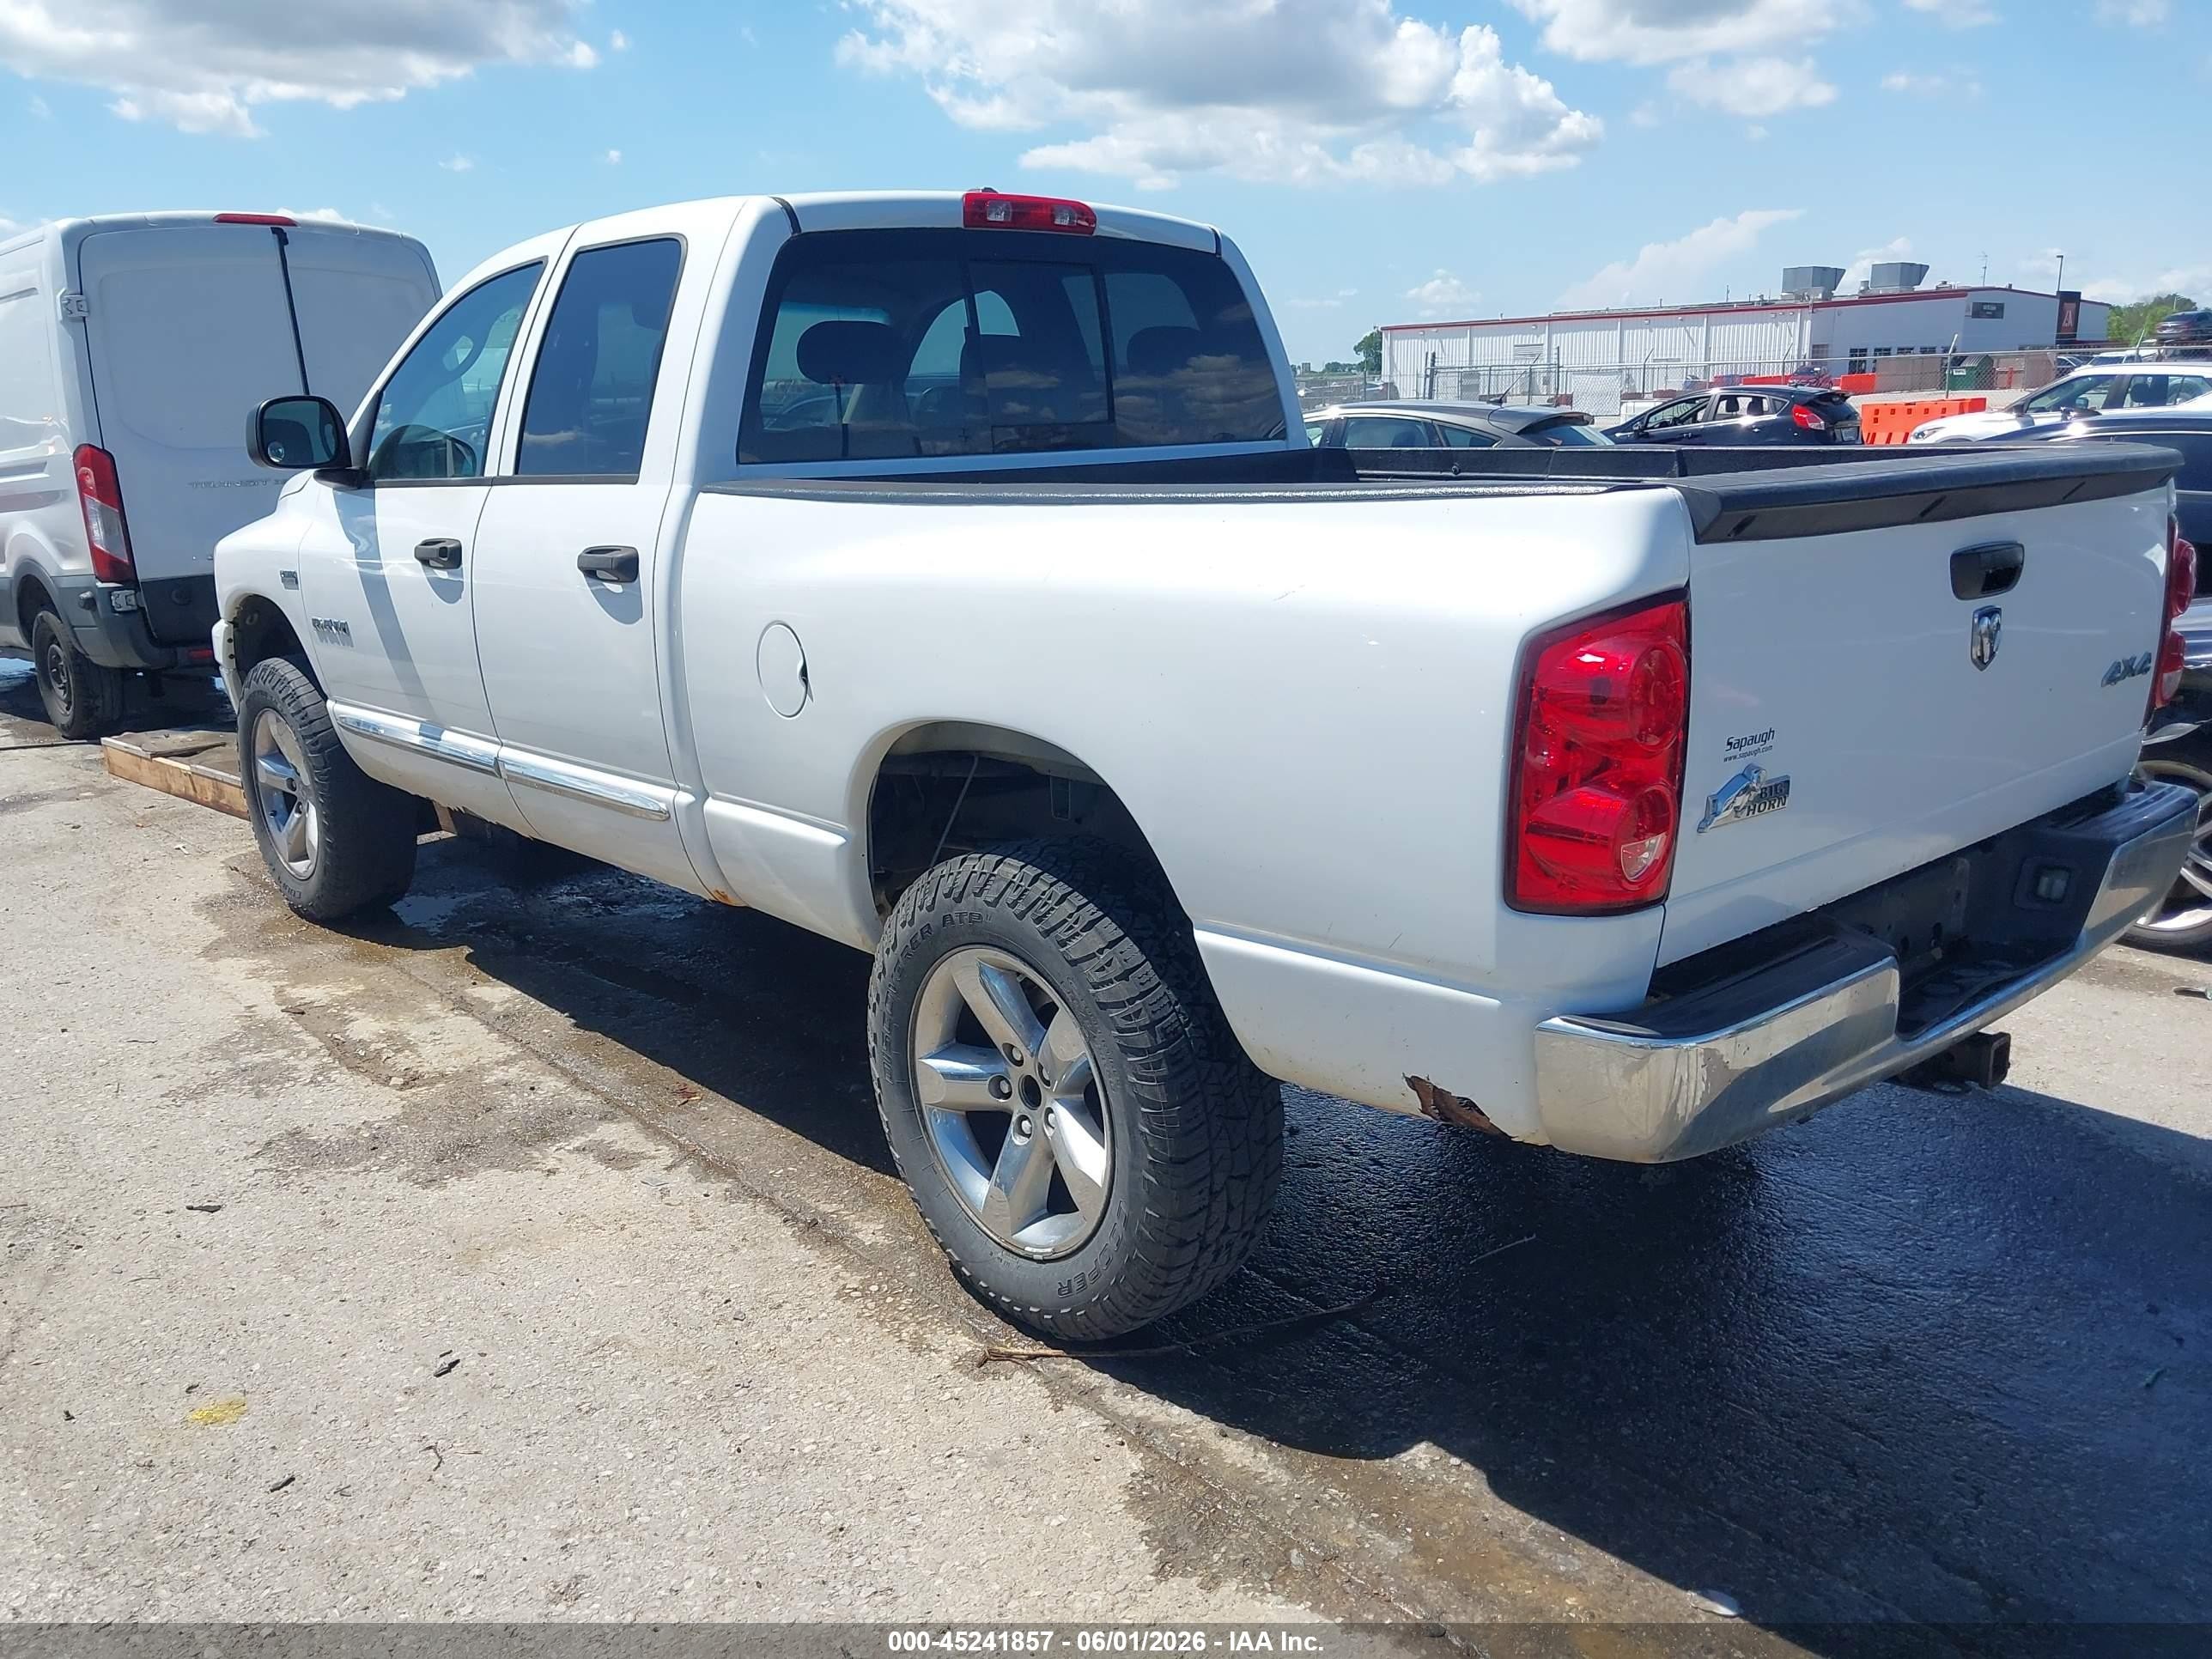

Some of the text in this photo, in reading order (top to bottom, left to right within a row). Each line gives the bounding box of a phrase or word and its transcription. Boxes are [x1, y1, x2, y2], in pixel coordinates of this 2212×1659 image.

[1724, 727, 1776, 752] Sapaugh
[1723, 744, 1773, 763] www.sapaugh.com
[1759, 782, 1784, 799] BIG
[1746, 796, 1787, 817] HORN
[1057, 1200, 1128, 1298] COOPER
